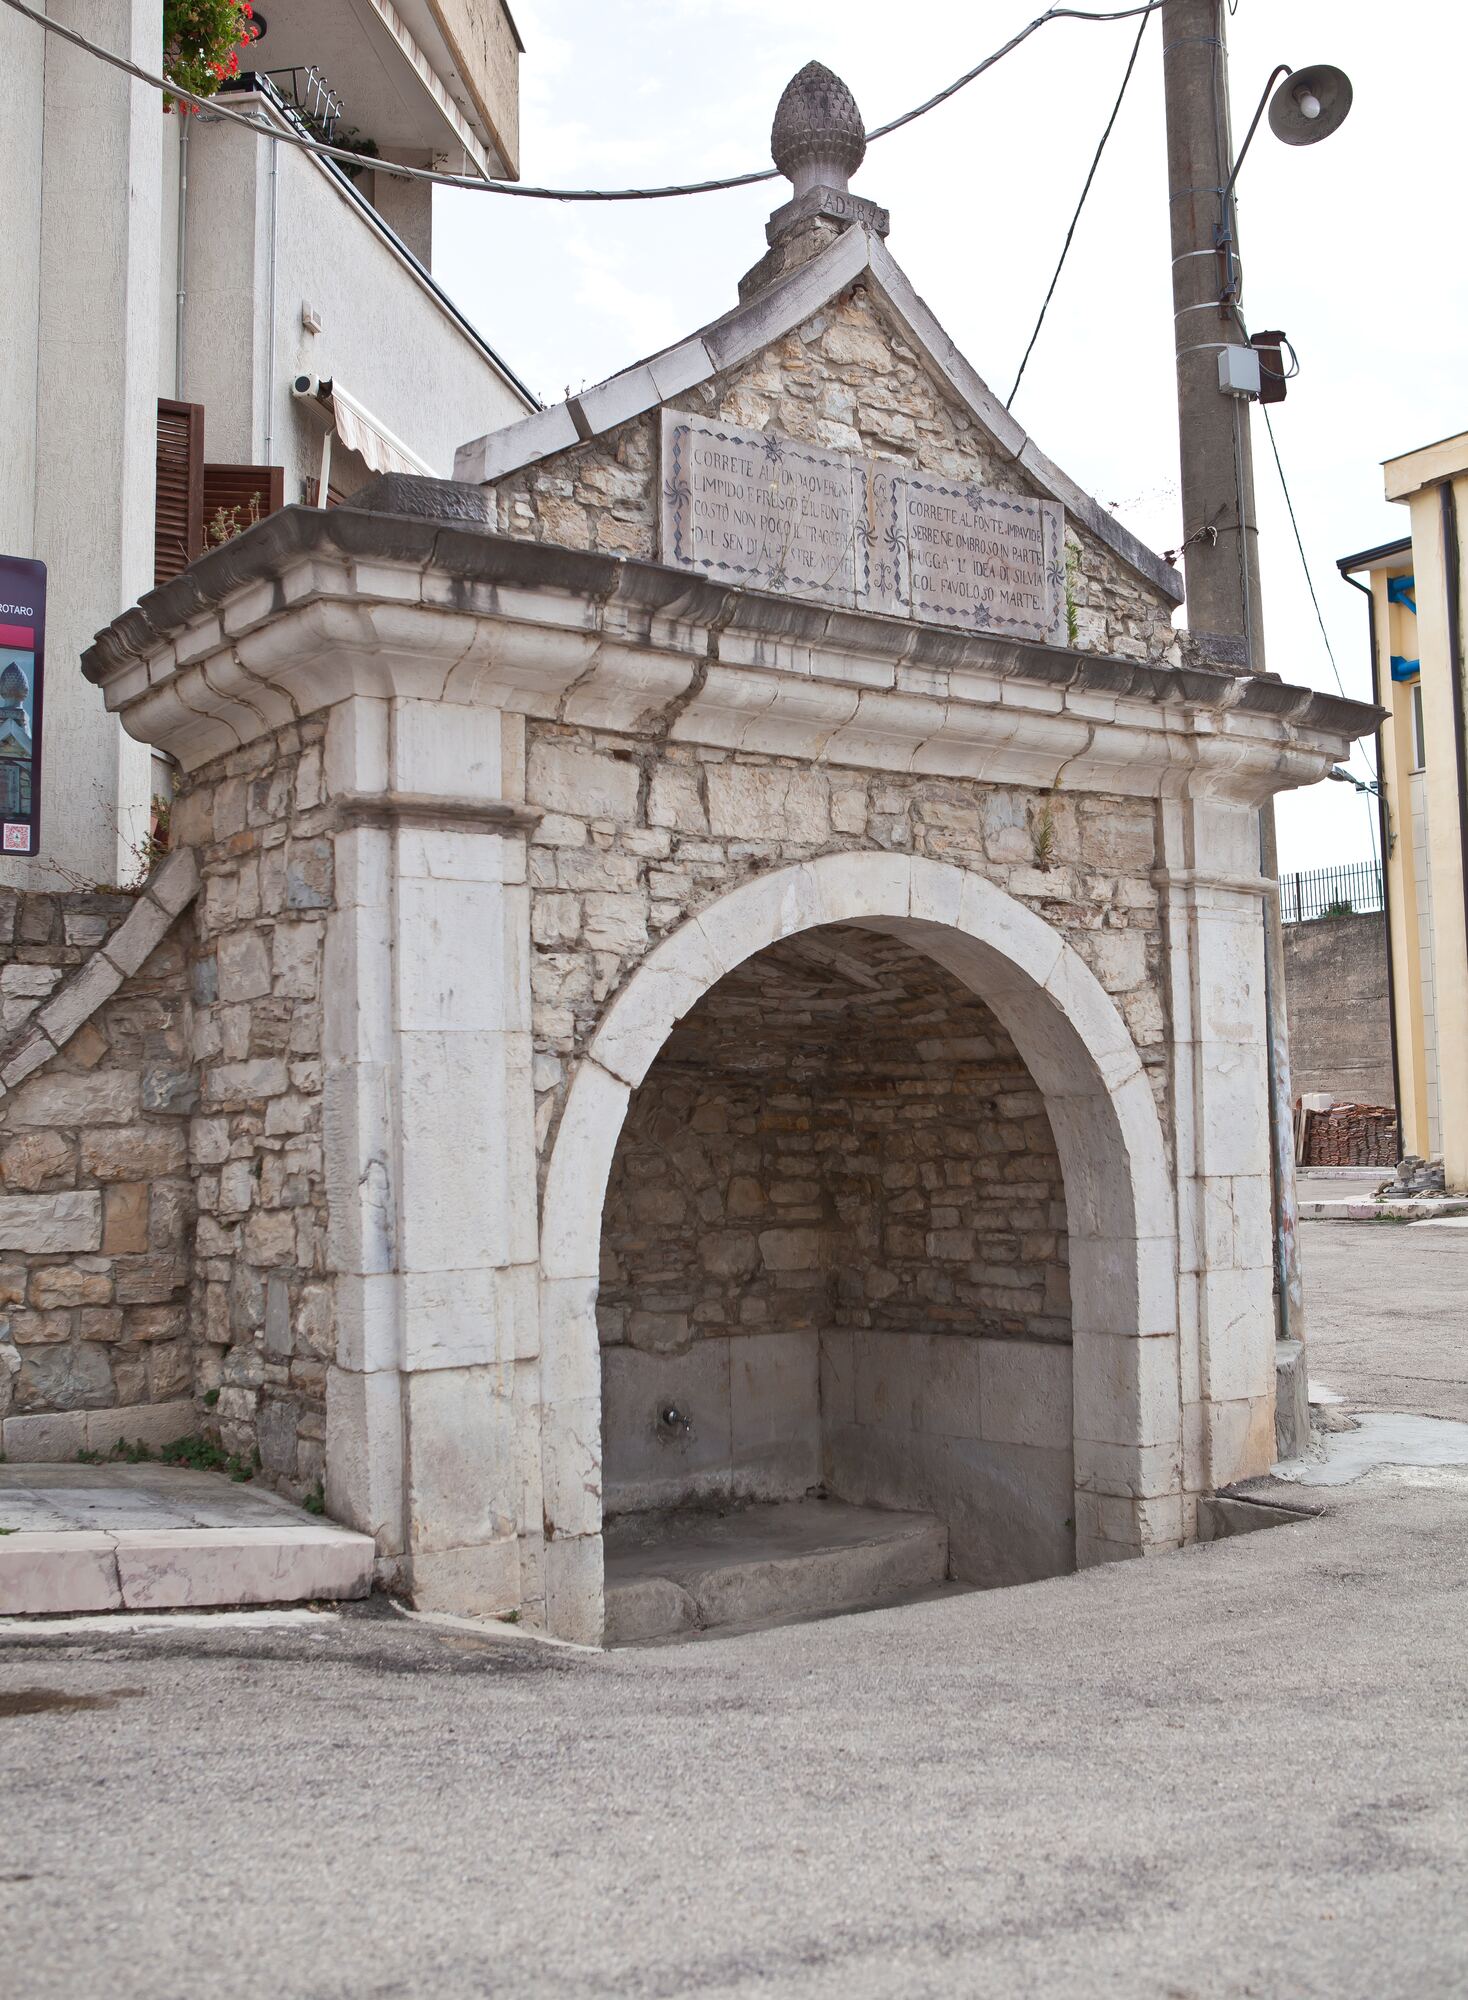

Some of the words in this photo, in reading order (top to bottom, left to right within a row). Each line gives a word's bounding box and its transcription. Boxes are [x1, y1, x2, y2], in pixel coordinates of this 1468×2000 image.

[694, 448, 754, 478] CORRETE
[694, 474, 744, 500] LIMPIDO
[733, 509, 756, 528] NON
[760, 515, 791, 536] POCO
[909, 500, 958, 525] CORRETE
[960, 512, 973, 528] AL
[694, 526, 719, 546] DAL
[722, 532, 744, 553] SEN
[911, 525, 954, 548] SEBBENE
[913, 573, 937, 592] COL
[1013, 569, 1043, 589] SILVIA
